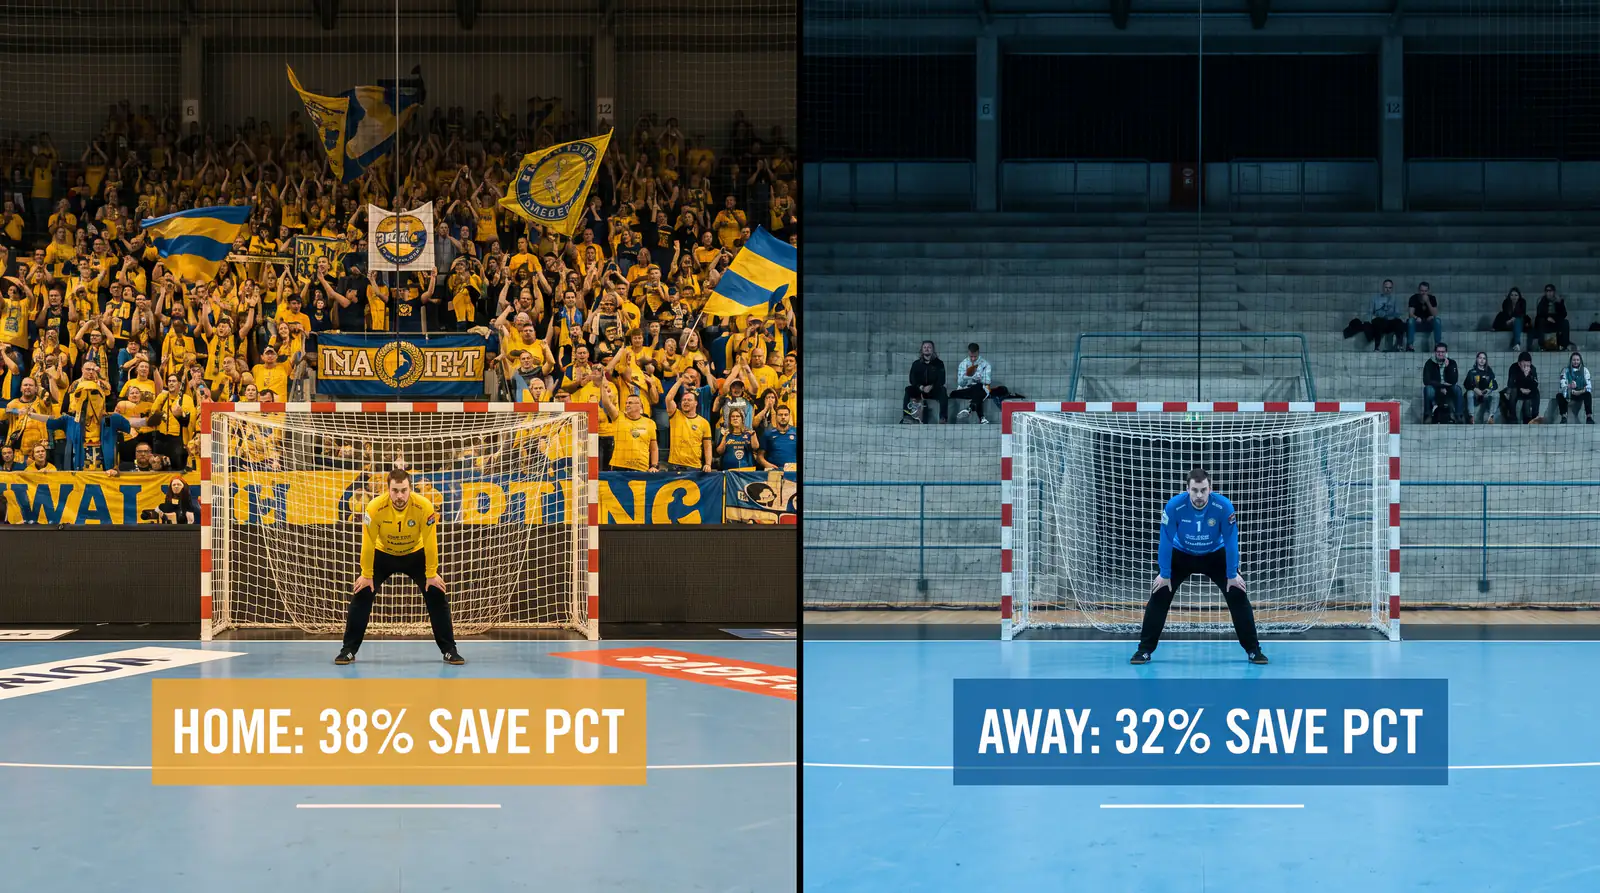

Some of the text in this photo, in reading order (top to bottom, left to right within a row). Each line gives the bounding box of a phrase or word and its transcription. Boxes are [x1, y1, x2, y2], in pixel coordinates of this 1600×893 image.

[187, 105, 195, 116] 6
[598, 103, 612, 114] 12
[982, 103, 990, 115] 6
[1387, 102, 1400, 114] 12
[397, 521, 402, 533] 1
[1196, 521, 1201, 532] 1
